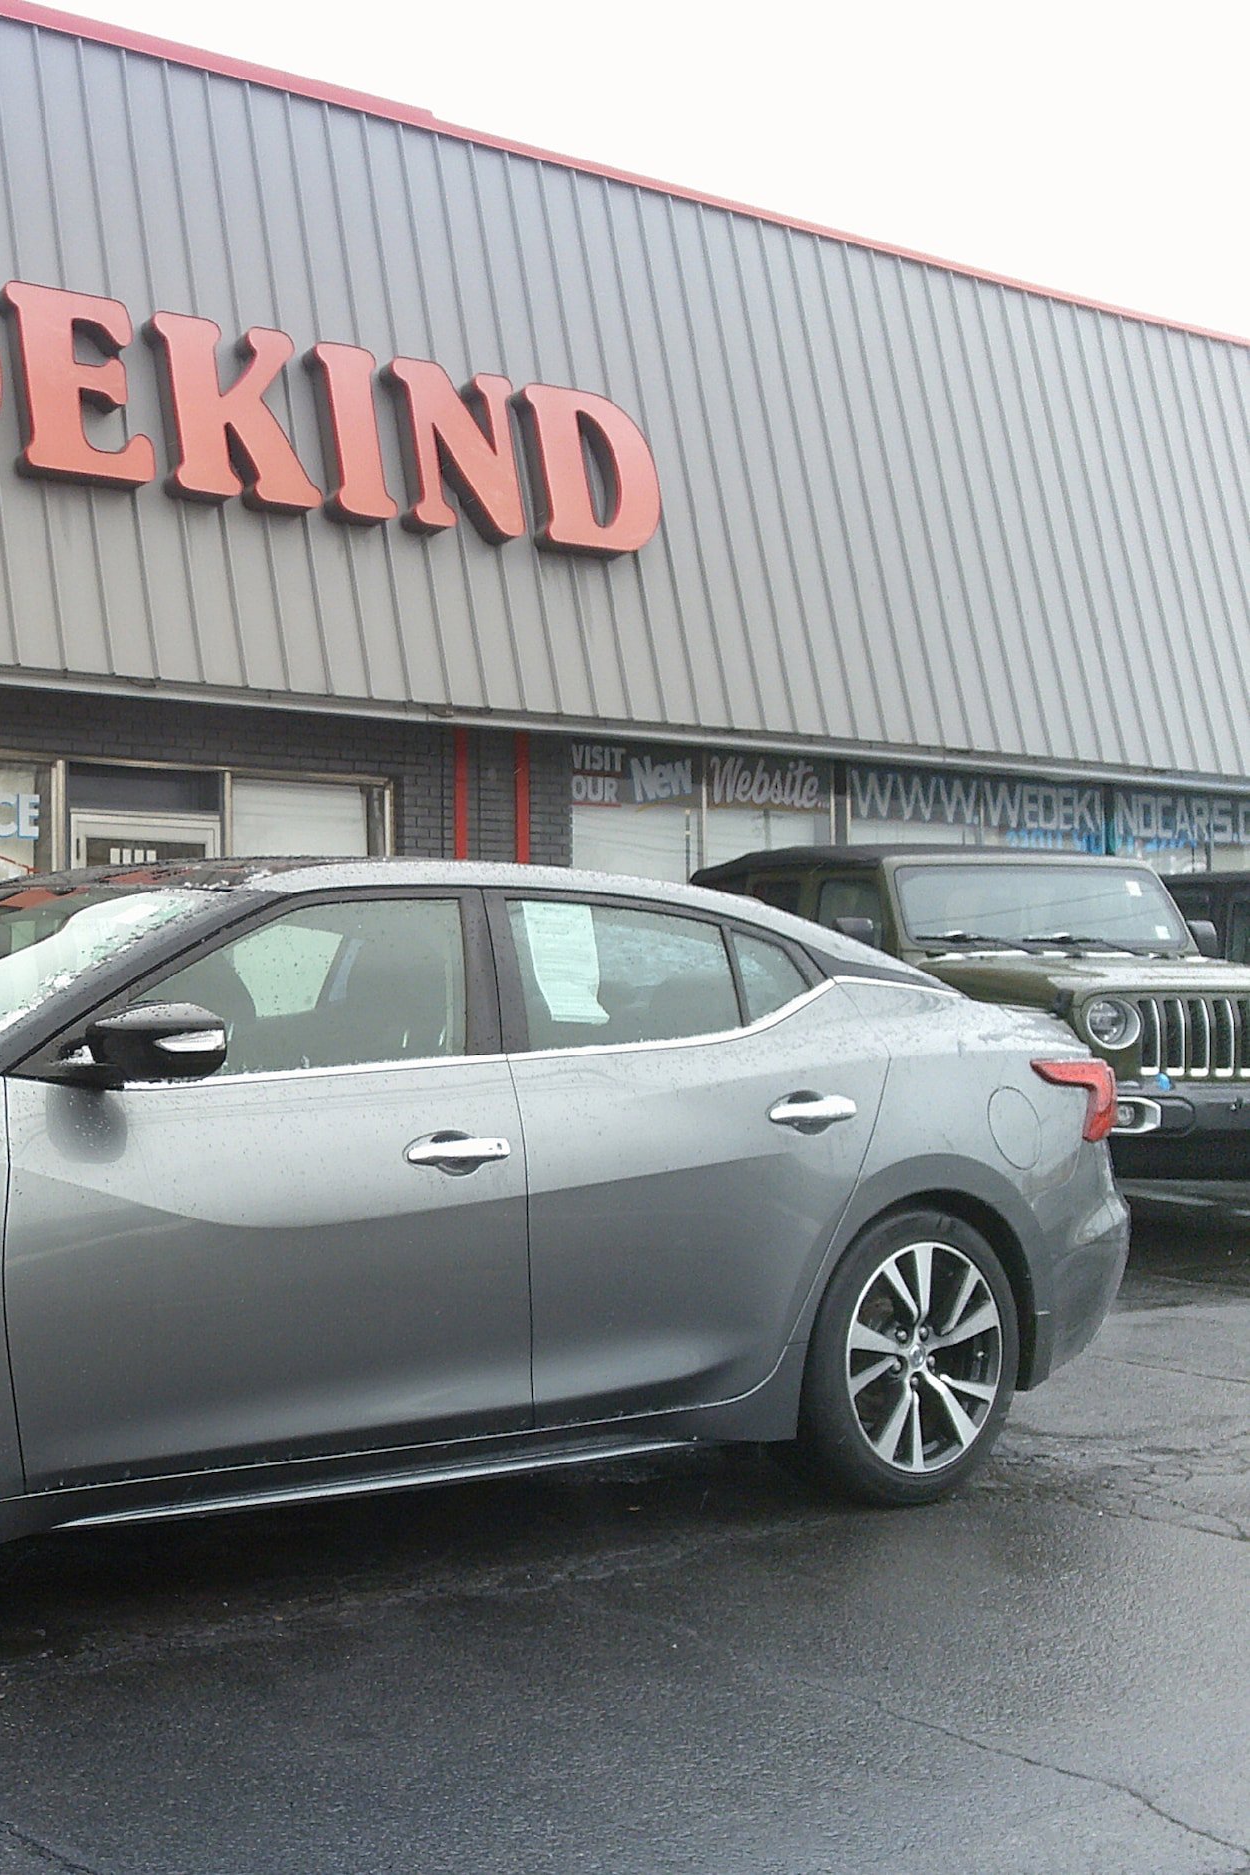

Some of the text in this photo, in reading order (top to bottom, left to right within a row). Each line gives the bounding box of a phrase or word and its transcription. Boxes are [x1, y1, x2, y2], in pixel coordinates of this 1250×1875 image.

[572, 744, 626, 771] VISIT
[572, 775, 618, 801] OUR
[630, 755, 692, 804] New
